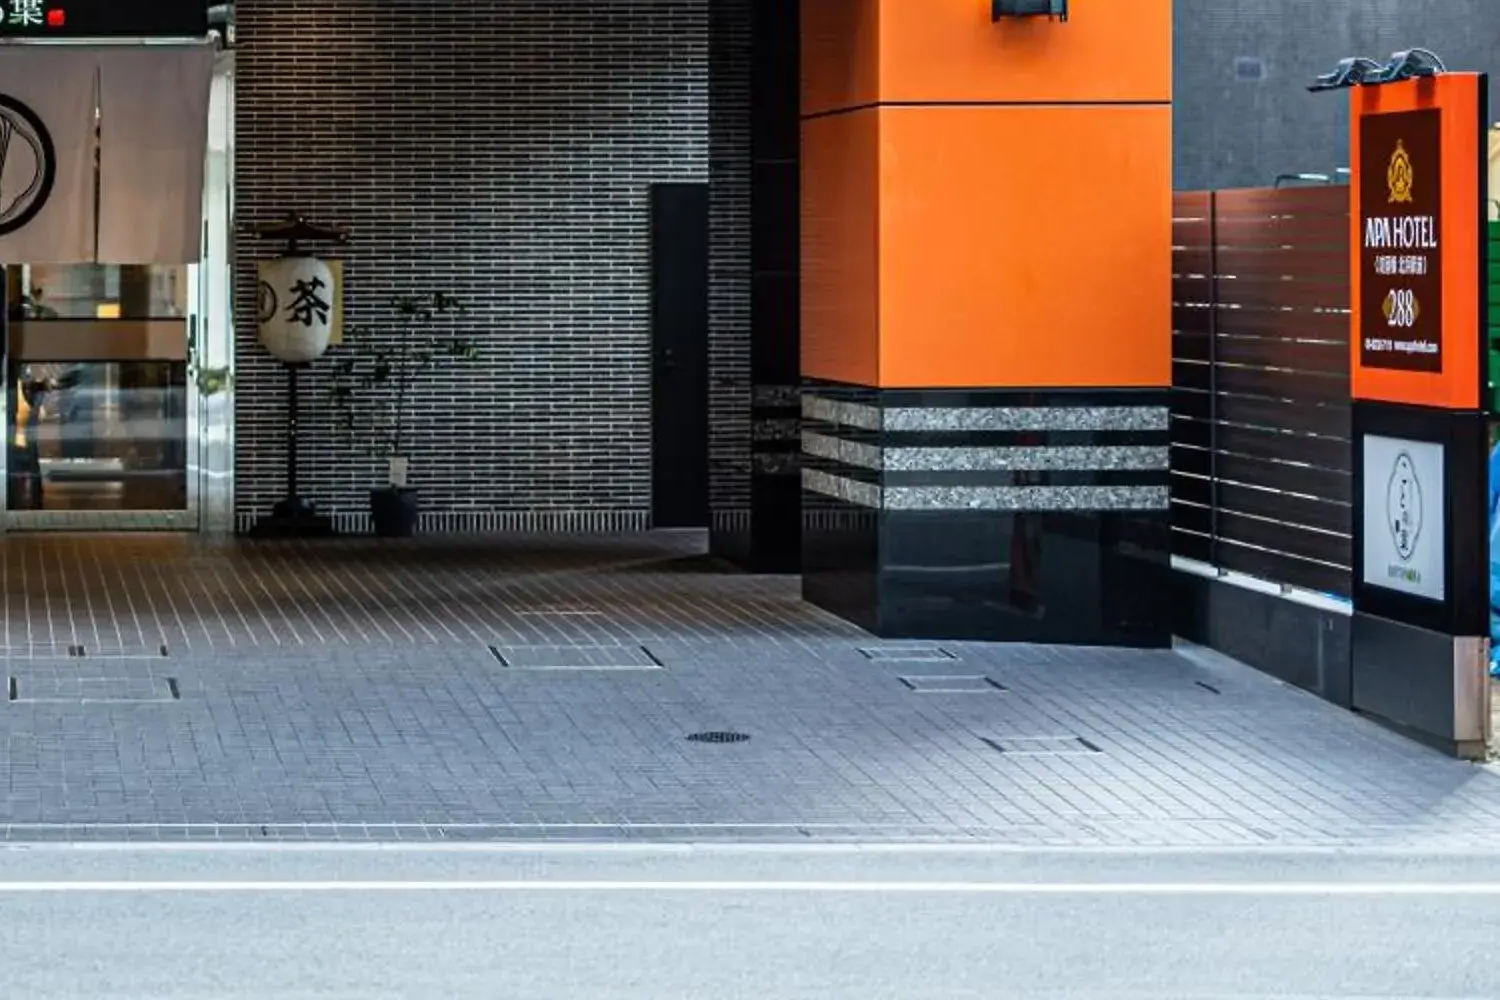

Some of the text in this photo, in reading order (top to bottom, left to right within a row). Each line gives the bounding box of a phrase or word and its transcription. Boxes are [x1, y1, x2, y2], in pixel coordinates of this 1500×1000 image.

[1365, 215, 1437, 249] APA HOTEL
[284, 276, 330, 328] 茶
[1387, 288, 1414, 328] 288
